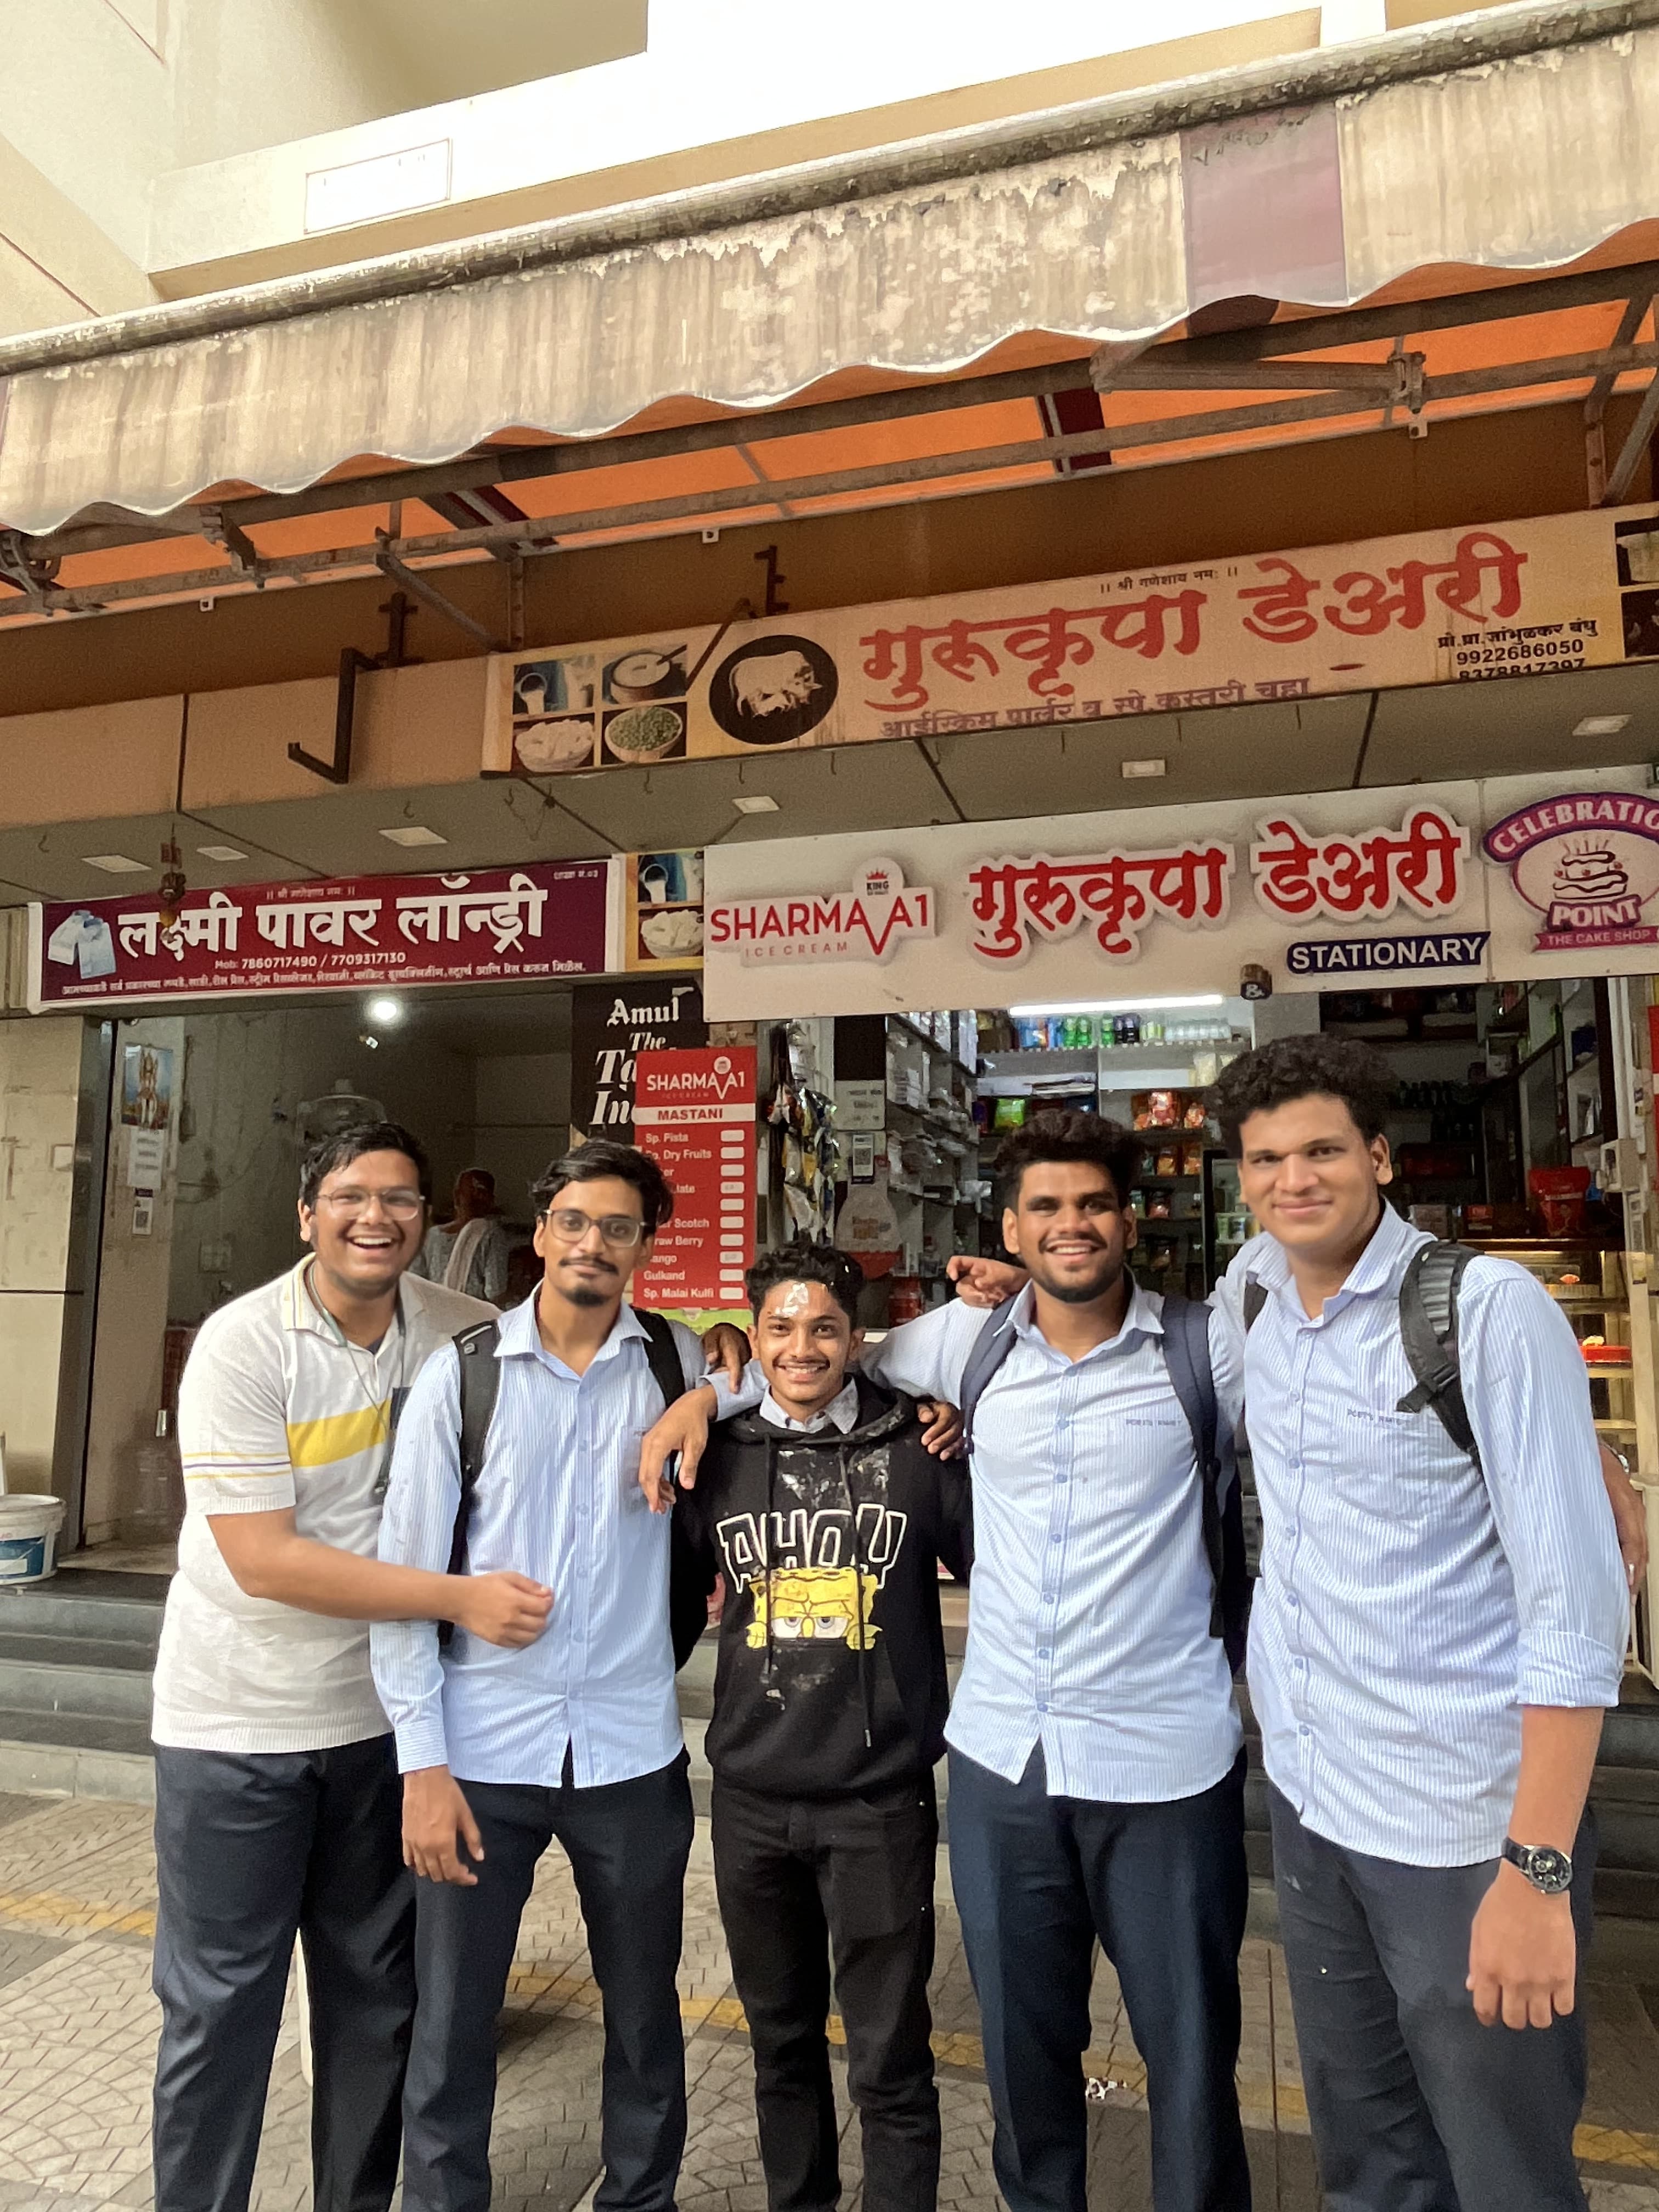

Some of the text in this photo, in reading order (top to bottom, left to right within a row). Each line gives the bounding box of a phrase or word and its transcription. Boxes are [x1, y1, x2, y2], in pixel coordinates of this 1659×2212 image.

[1237, 532, 1528, 644] डेअरी
[1457, 639, 1584, 665] 9922686050
[1259, 811, 1461, 913] डेअरी
[1551, 900, 1638, 928] POINT
[256, 898, 382, 949] पावर
[1548, 929, 1650, 946] THE CAKE SHOP
[746, 941, 848, 958] ICE CREAM
[1291, 936, 1482, 969] STATIONARY
[241, 956, 317, 969] 7860717490
[331, 952, 407, 967] 7709317130
[607, 995, 679, 1028] Amul
[629, 1031, 666, 1051] The
[658, 1108, 723, 1120] MASTANI
[645, 1133, 659, 1144] Sp.
[663, 1149, 681, 1161] Dry
[684, 1149, 712, 1159] Fruits
[674, 1217, 710, 1228] Scotch
[675, 1235, 704, 1248] Berry
[650, 1255, 678, 1266] ango
[643, 1270, 686, 1280] Gulkand
[643, 1287, 714, 1301] Sp. Malai Kulfi
